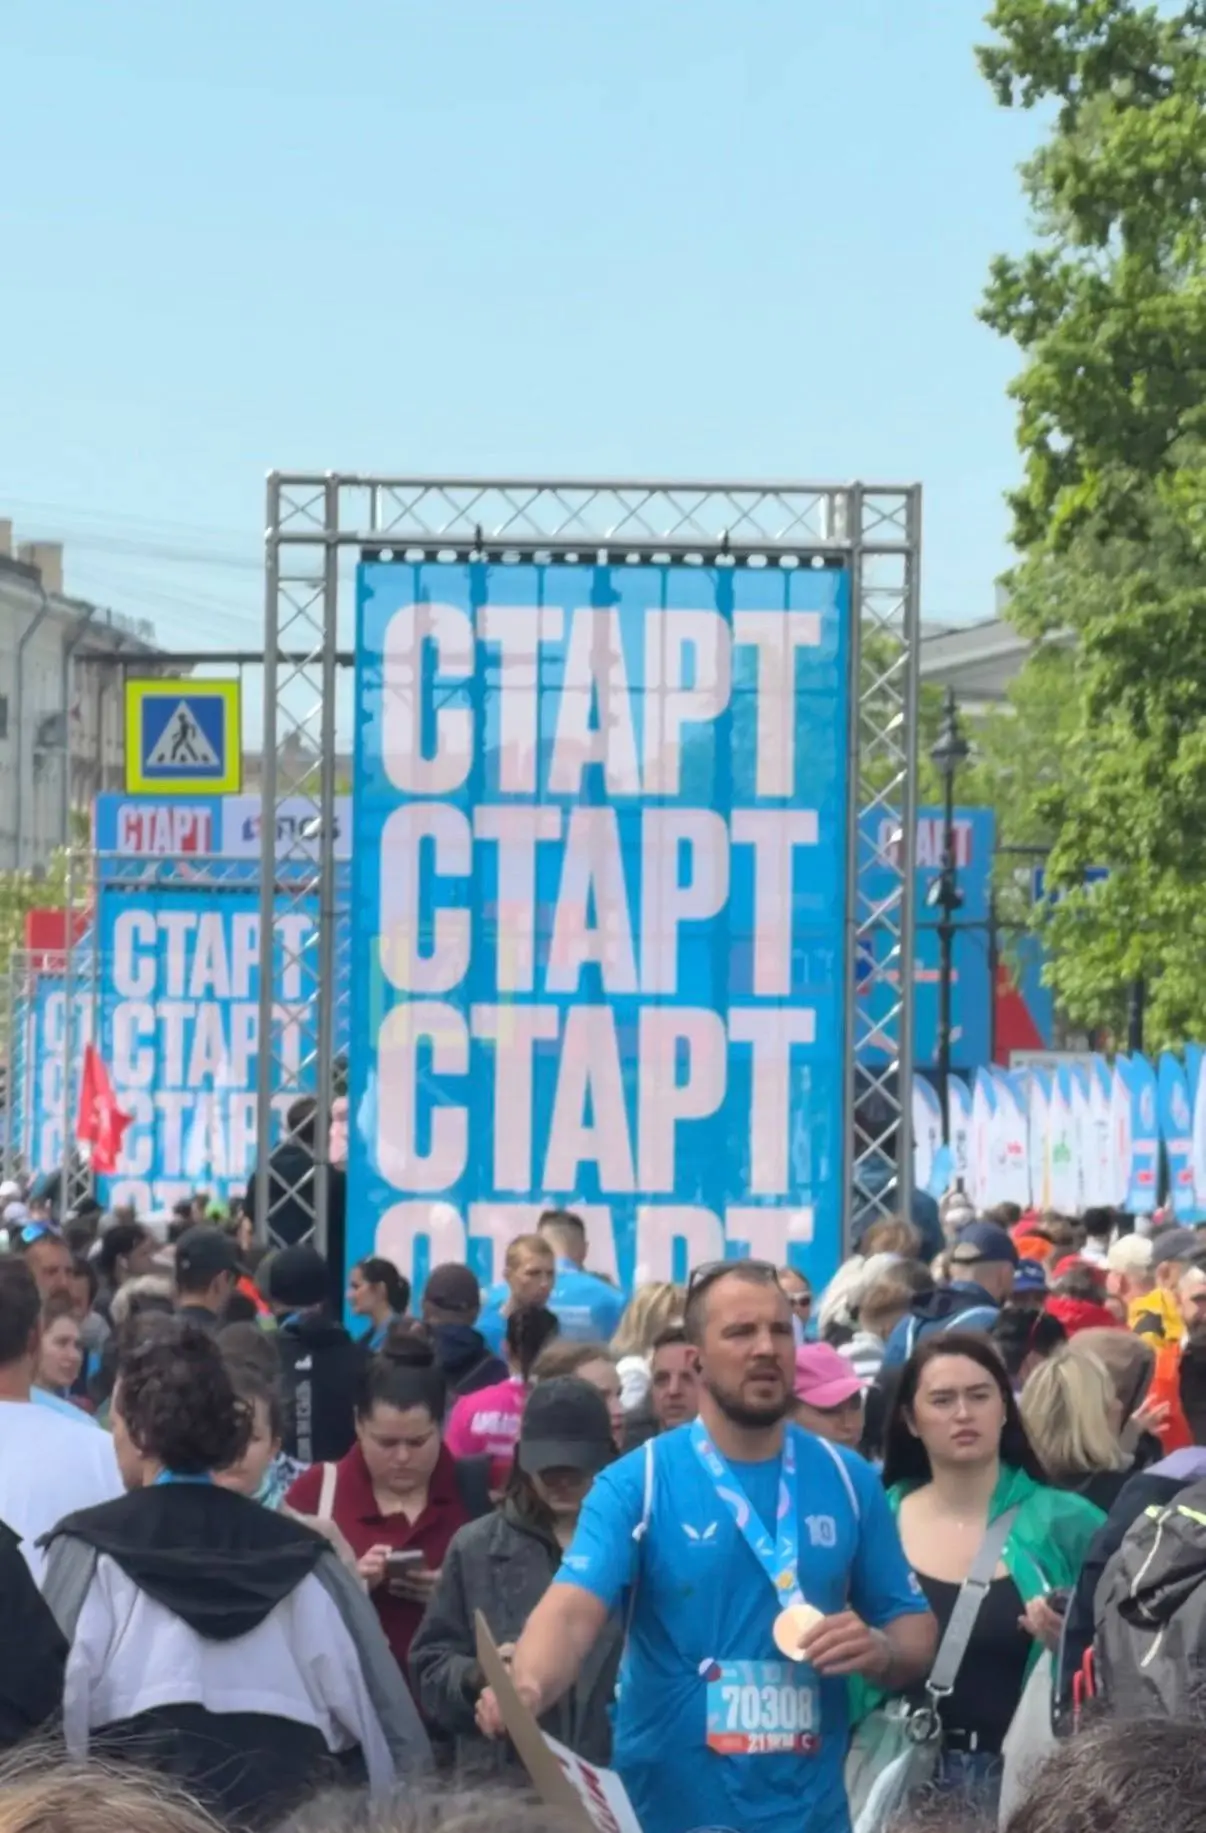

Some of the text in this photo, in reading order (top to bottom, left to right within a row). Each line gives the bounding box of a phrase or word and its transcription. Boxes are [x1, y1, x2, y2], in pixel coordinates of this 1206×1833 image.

[382, 602, 822, 797] СТАРТ
[117, 803, 212, 856] СТАРТ
[378, 802, 819, 996] СТАРТ
[375, 1001, 817, 1194] СТАРТ
[721, 1685, 813, 1730] 70308
